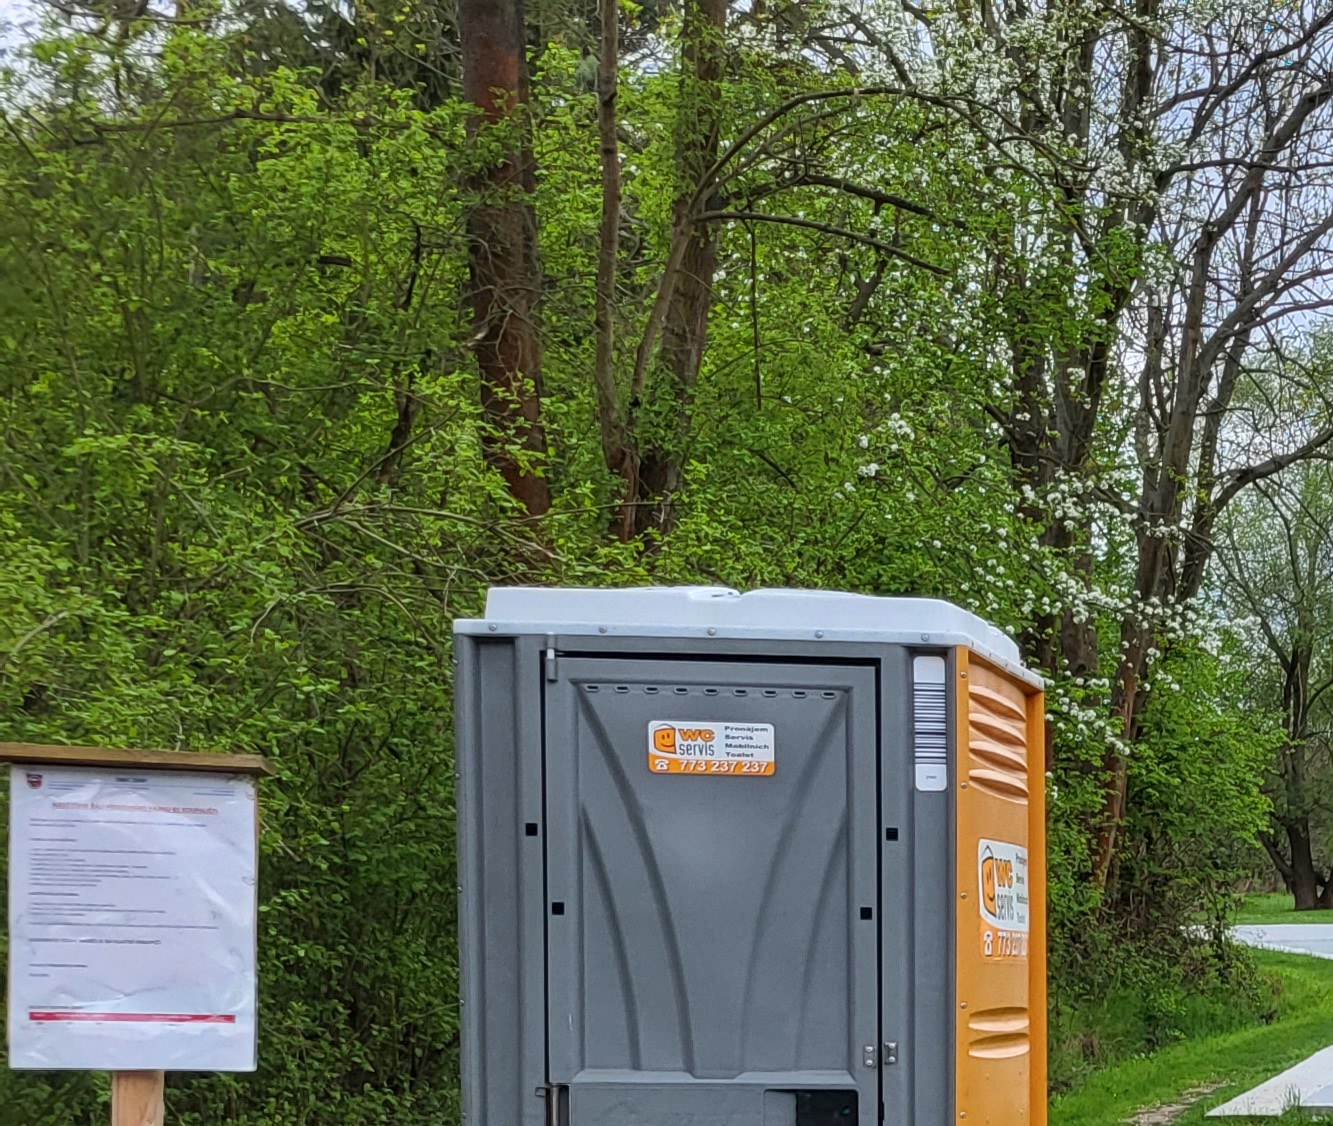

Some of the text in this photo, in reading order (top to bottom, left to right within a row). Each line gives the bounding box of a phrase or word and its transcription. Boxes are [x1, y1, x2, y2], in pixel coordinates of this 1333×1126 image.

[678, 728, 715, 742] WC
[678, 742, 714, 756] servis
[679, 760, 768, 773] 773 237 237
